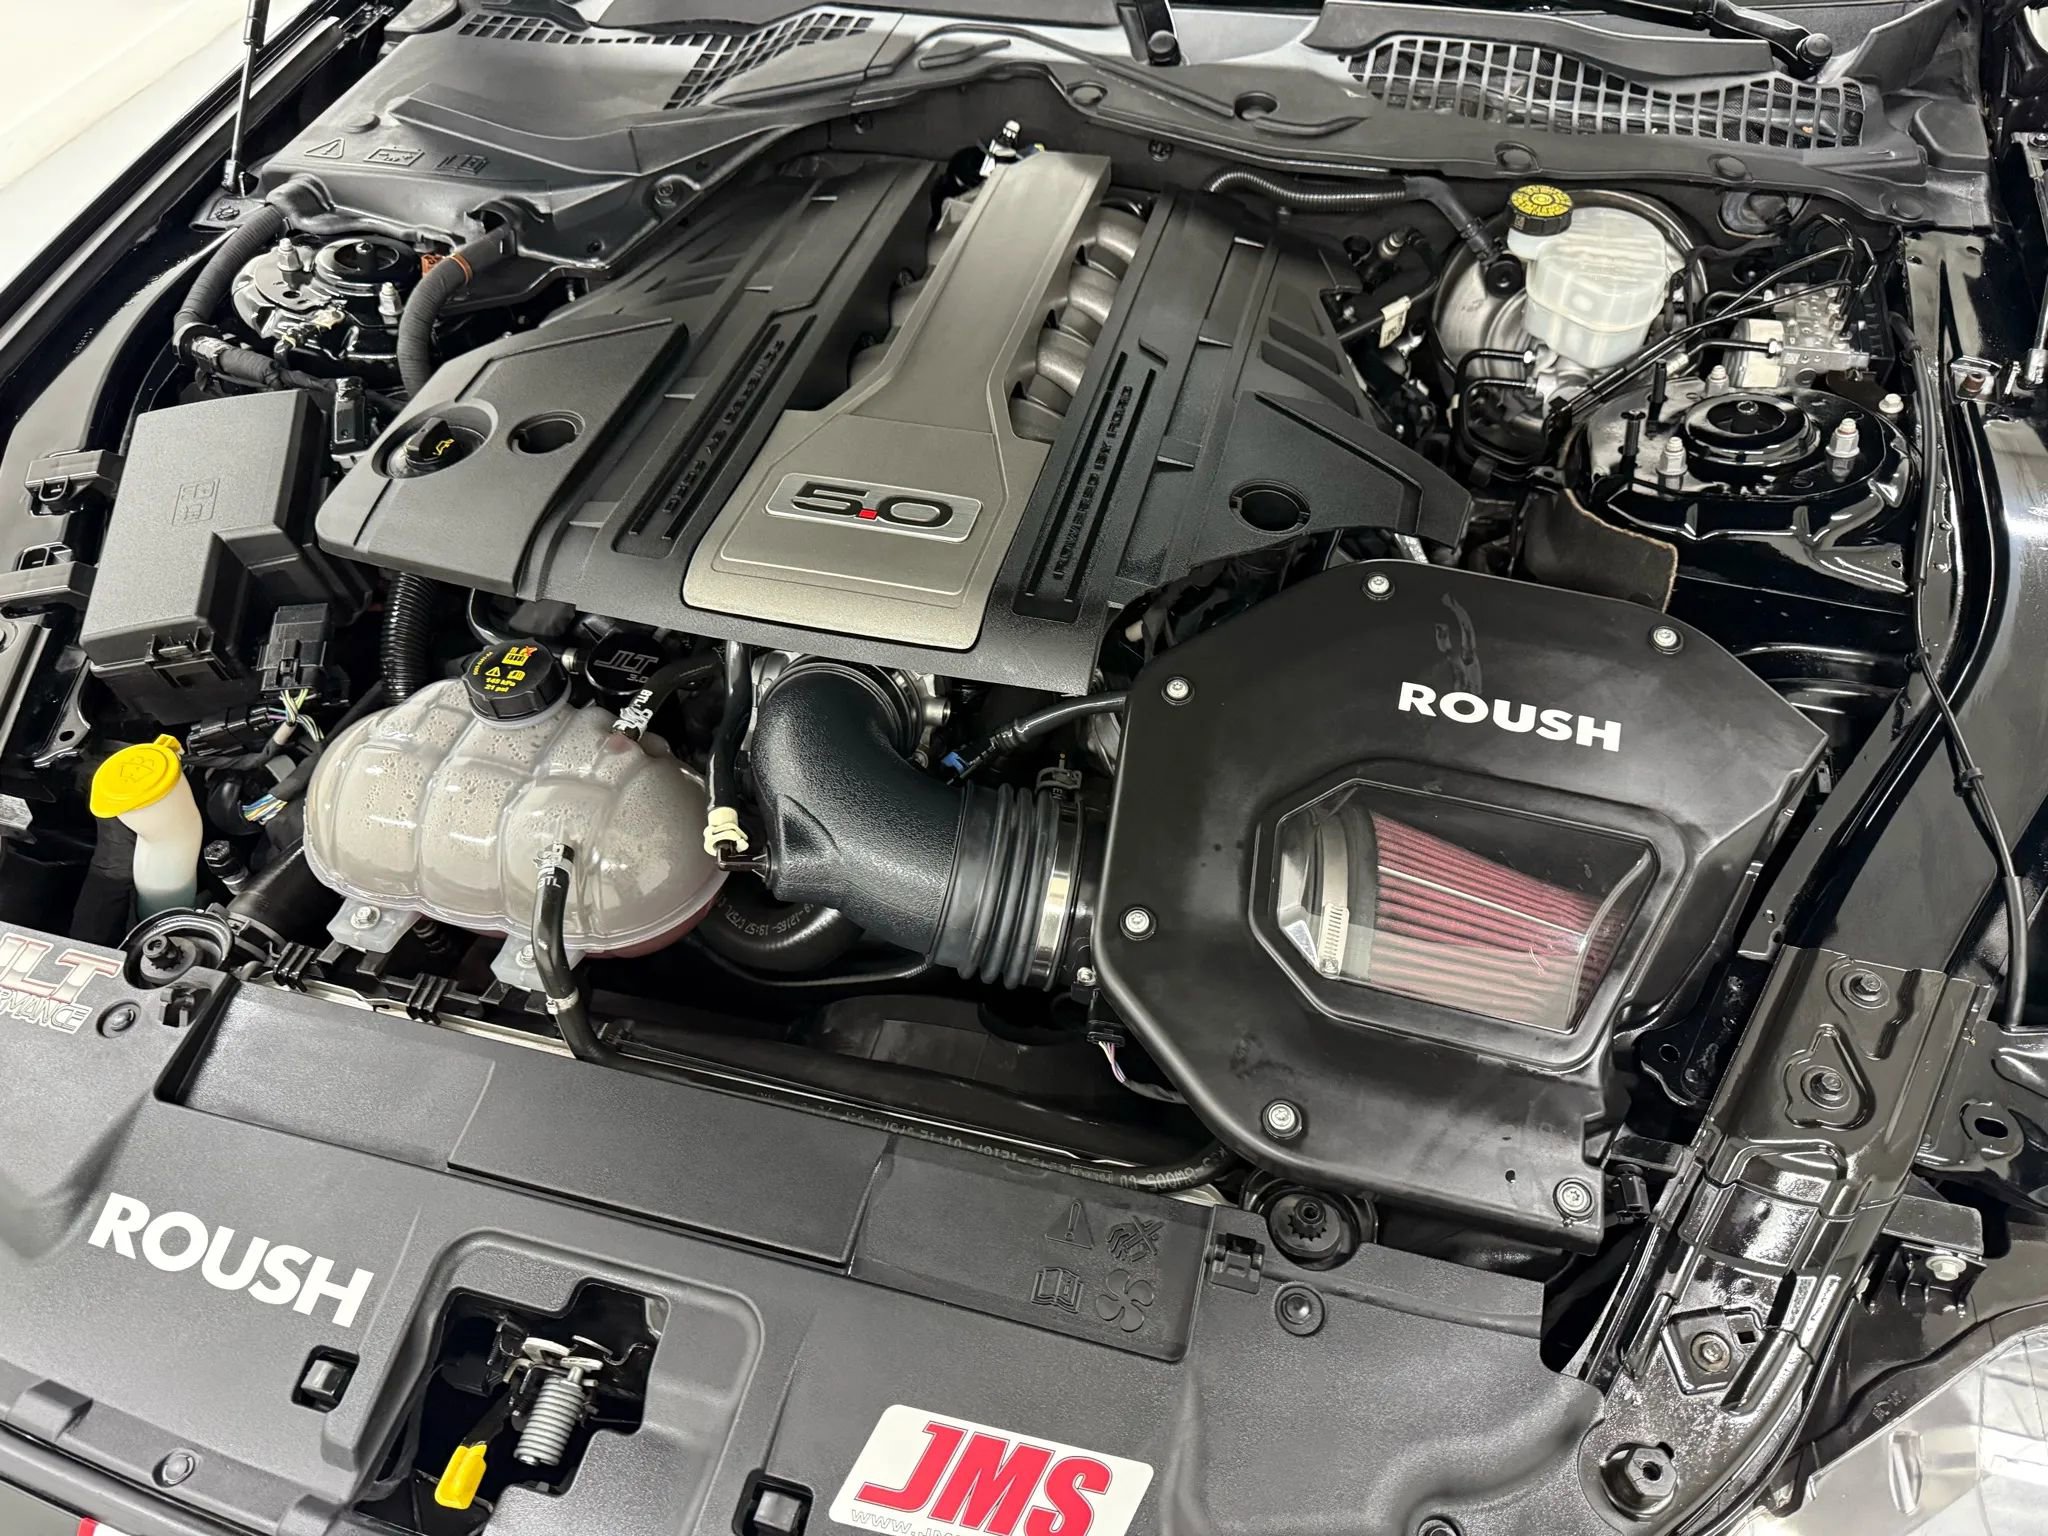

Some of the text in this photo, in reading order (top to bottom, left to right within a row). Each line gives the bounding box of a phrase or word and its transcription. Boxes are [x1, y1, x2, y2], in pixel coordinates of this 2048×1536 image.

[790, 480, 954, 529] 5.0
[593, 650, 659, 674] JLT
[1398, 681, 1622, 753] ROUSH
[88, 1192, 375, 1328] ROUSH
[854, 1420, 1113, 1536] JMS
